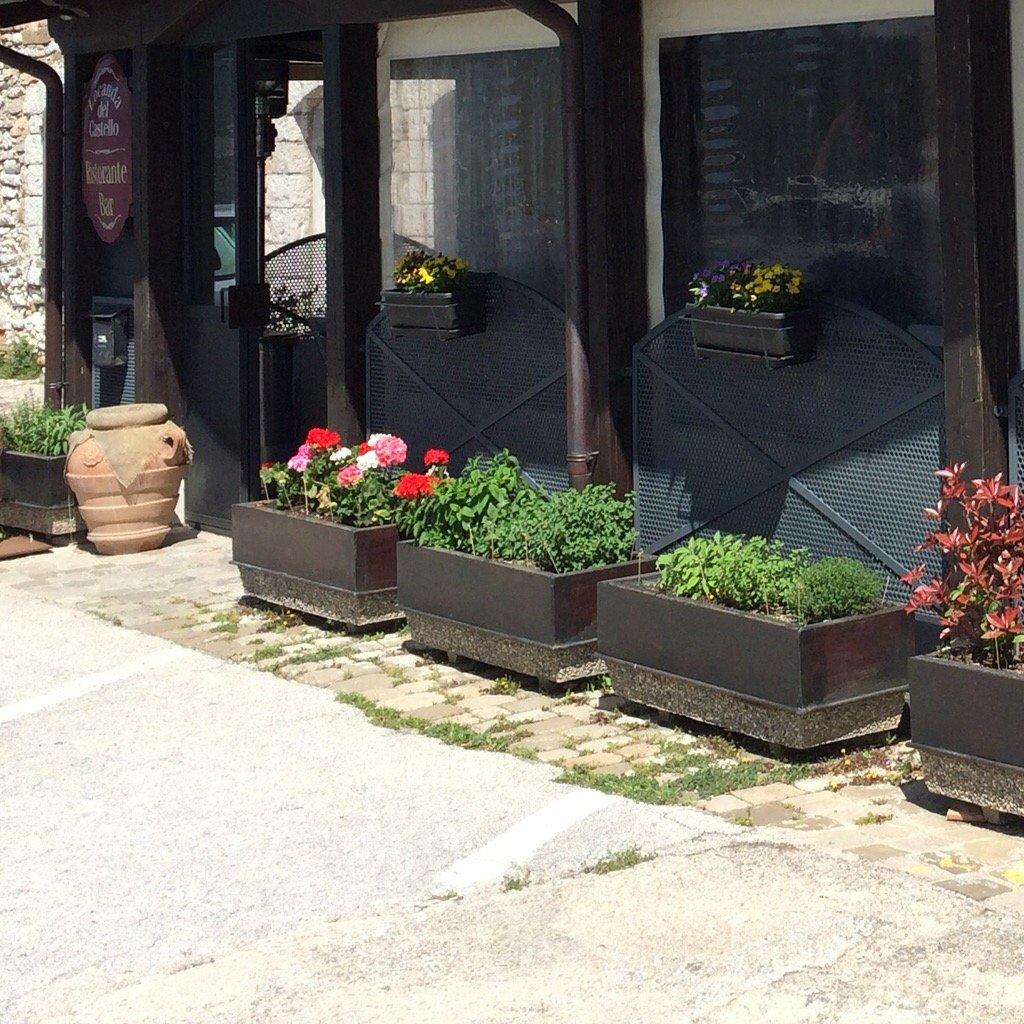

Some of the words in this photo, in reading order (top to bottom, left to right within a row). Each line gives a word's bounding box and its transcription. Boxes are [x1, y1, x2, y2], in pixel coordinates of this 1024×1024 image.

[88, 83, 122, 111] Locanda
[97, 101, 109, 119] del
[89, 119, 119, 137] Castello
[86, 161, 127, 184] Ristorante
[98, 192, 114, 217] Bar
